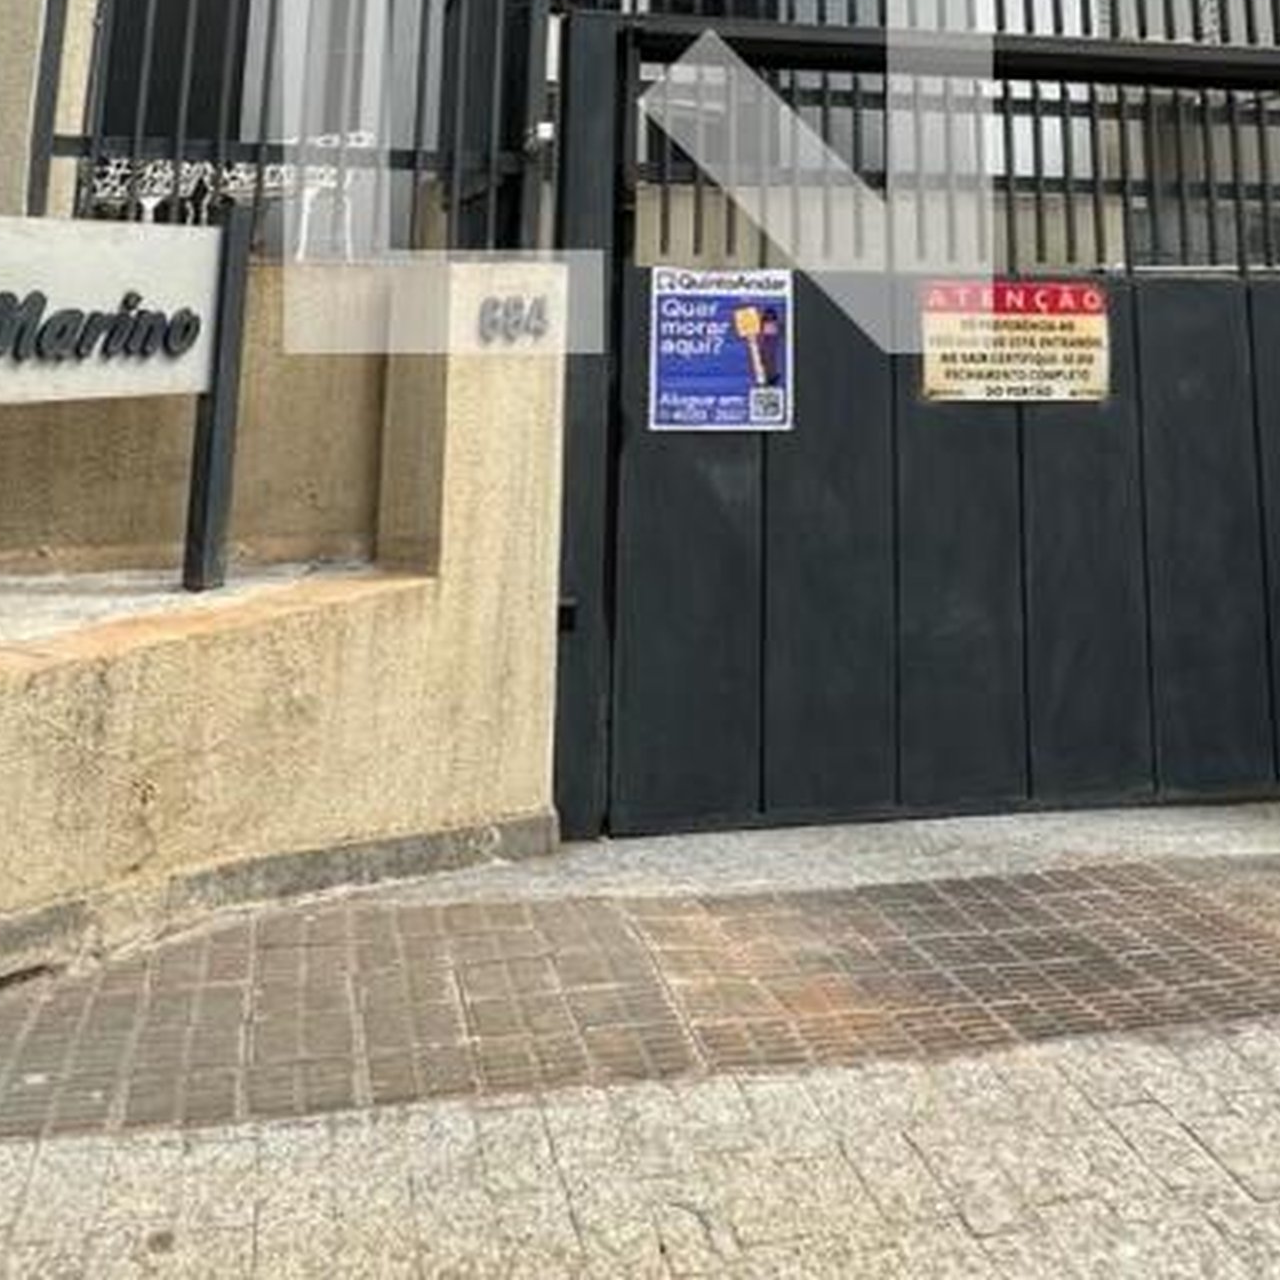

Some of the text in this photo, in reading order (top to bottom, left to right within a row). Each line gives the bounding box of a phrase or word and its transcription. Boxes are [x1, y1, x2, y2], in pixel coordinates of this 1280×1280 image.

[680, 273, 786, 290] QuintoAndar
[661, 298, 719, 317] Quer
[928, 285, 1103, 313] ATENÇÃO
[661, 336, 724, 356] aqui?
